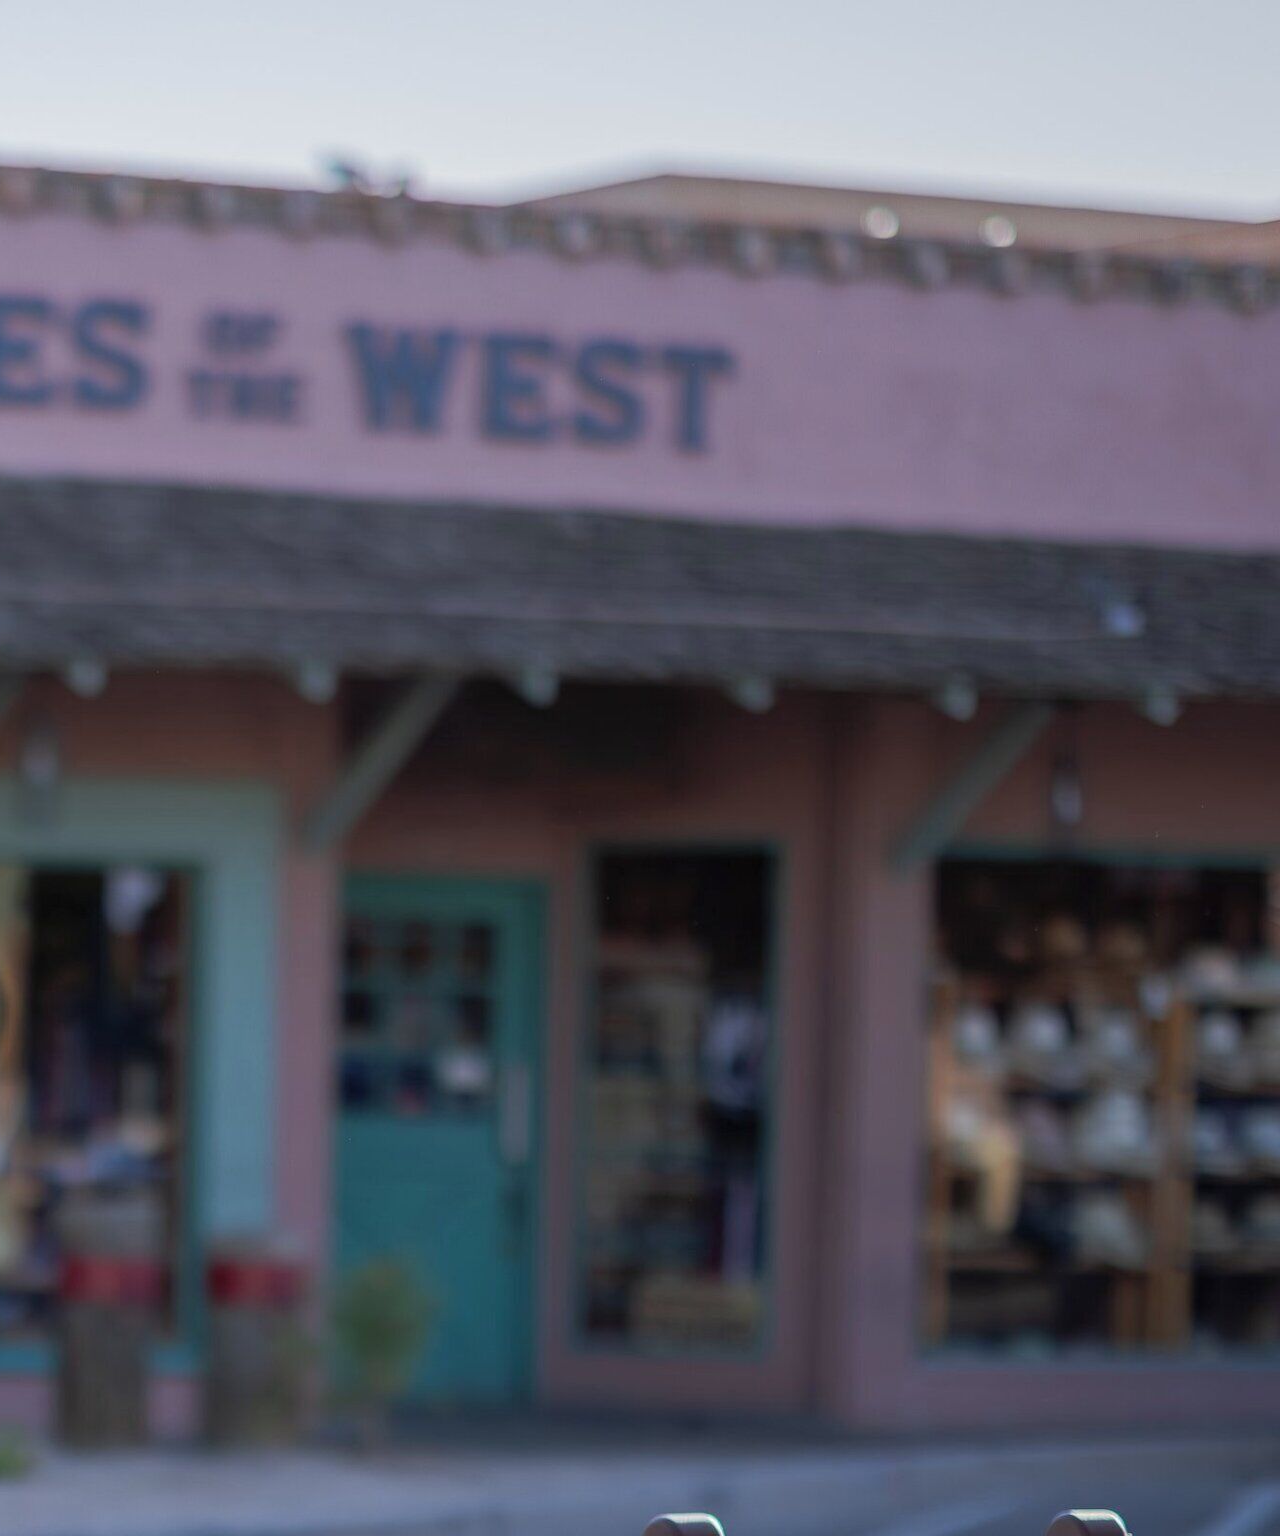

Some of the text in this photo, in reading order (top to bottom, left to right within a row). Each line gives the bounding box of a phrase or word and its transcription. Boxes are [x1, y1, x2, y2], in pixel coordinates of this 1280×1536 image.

[203, 310, 280, 356] OF
[186, 367, 302, 425] THE
[340, 320, 740, 456] WEST
